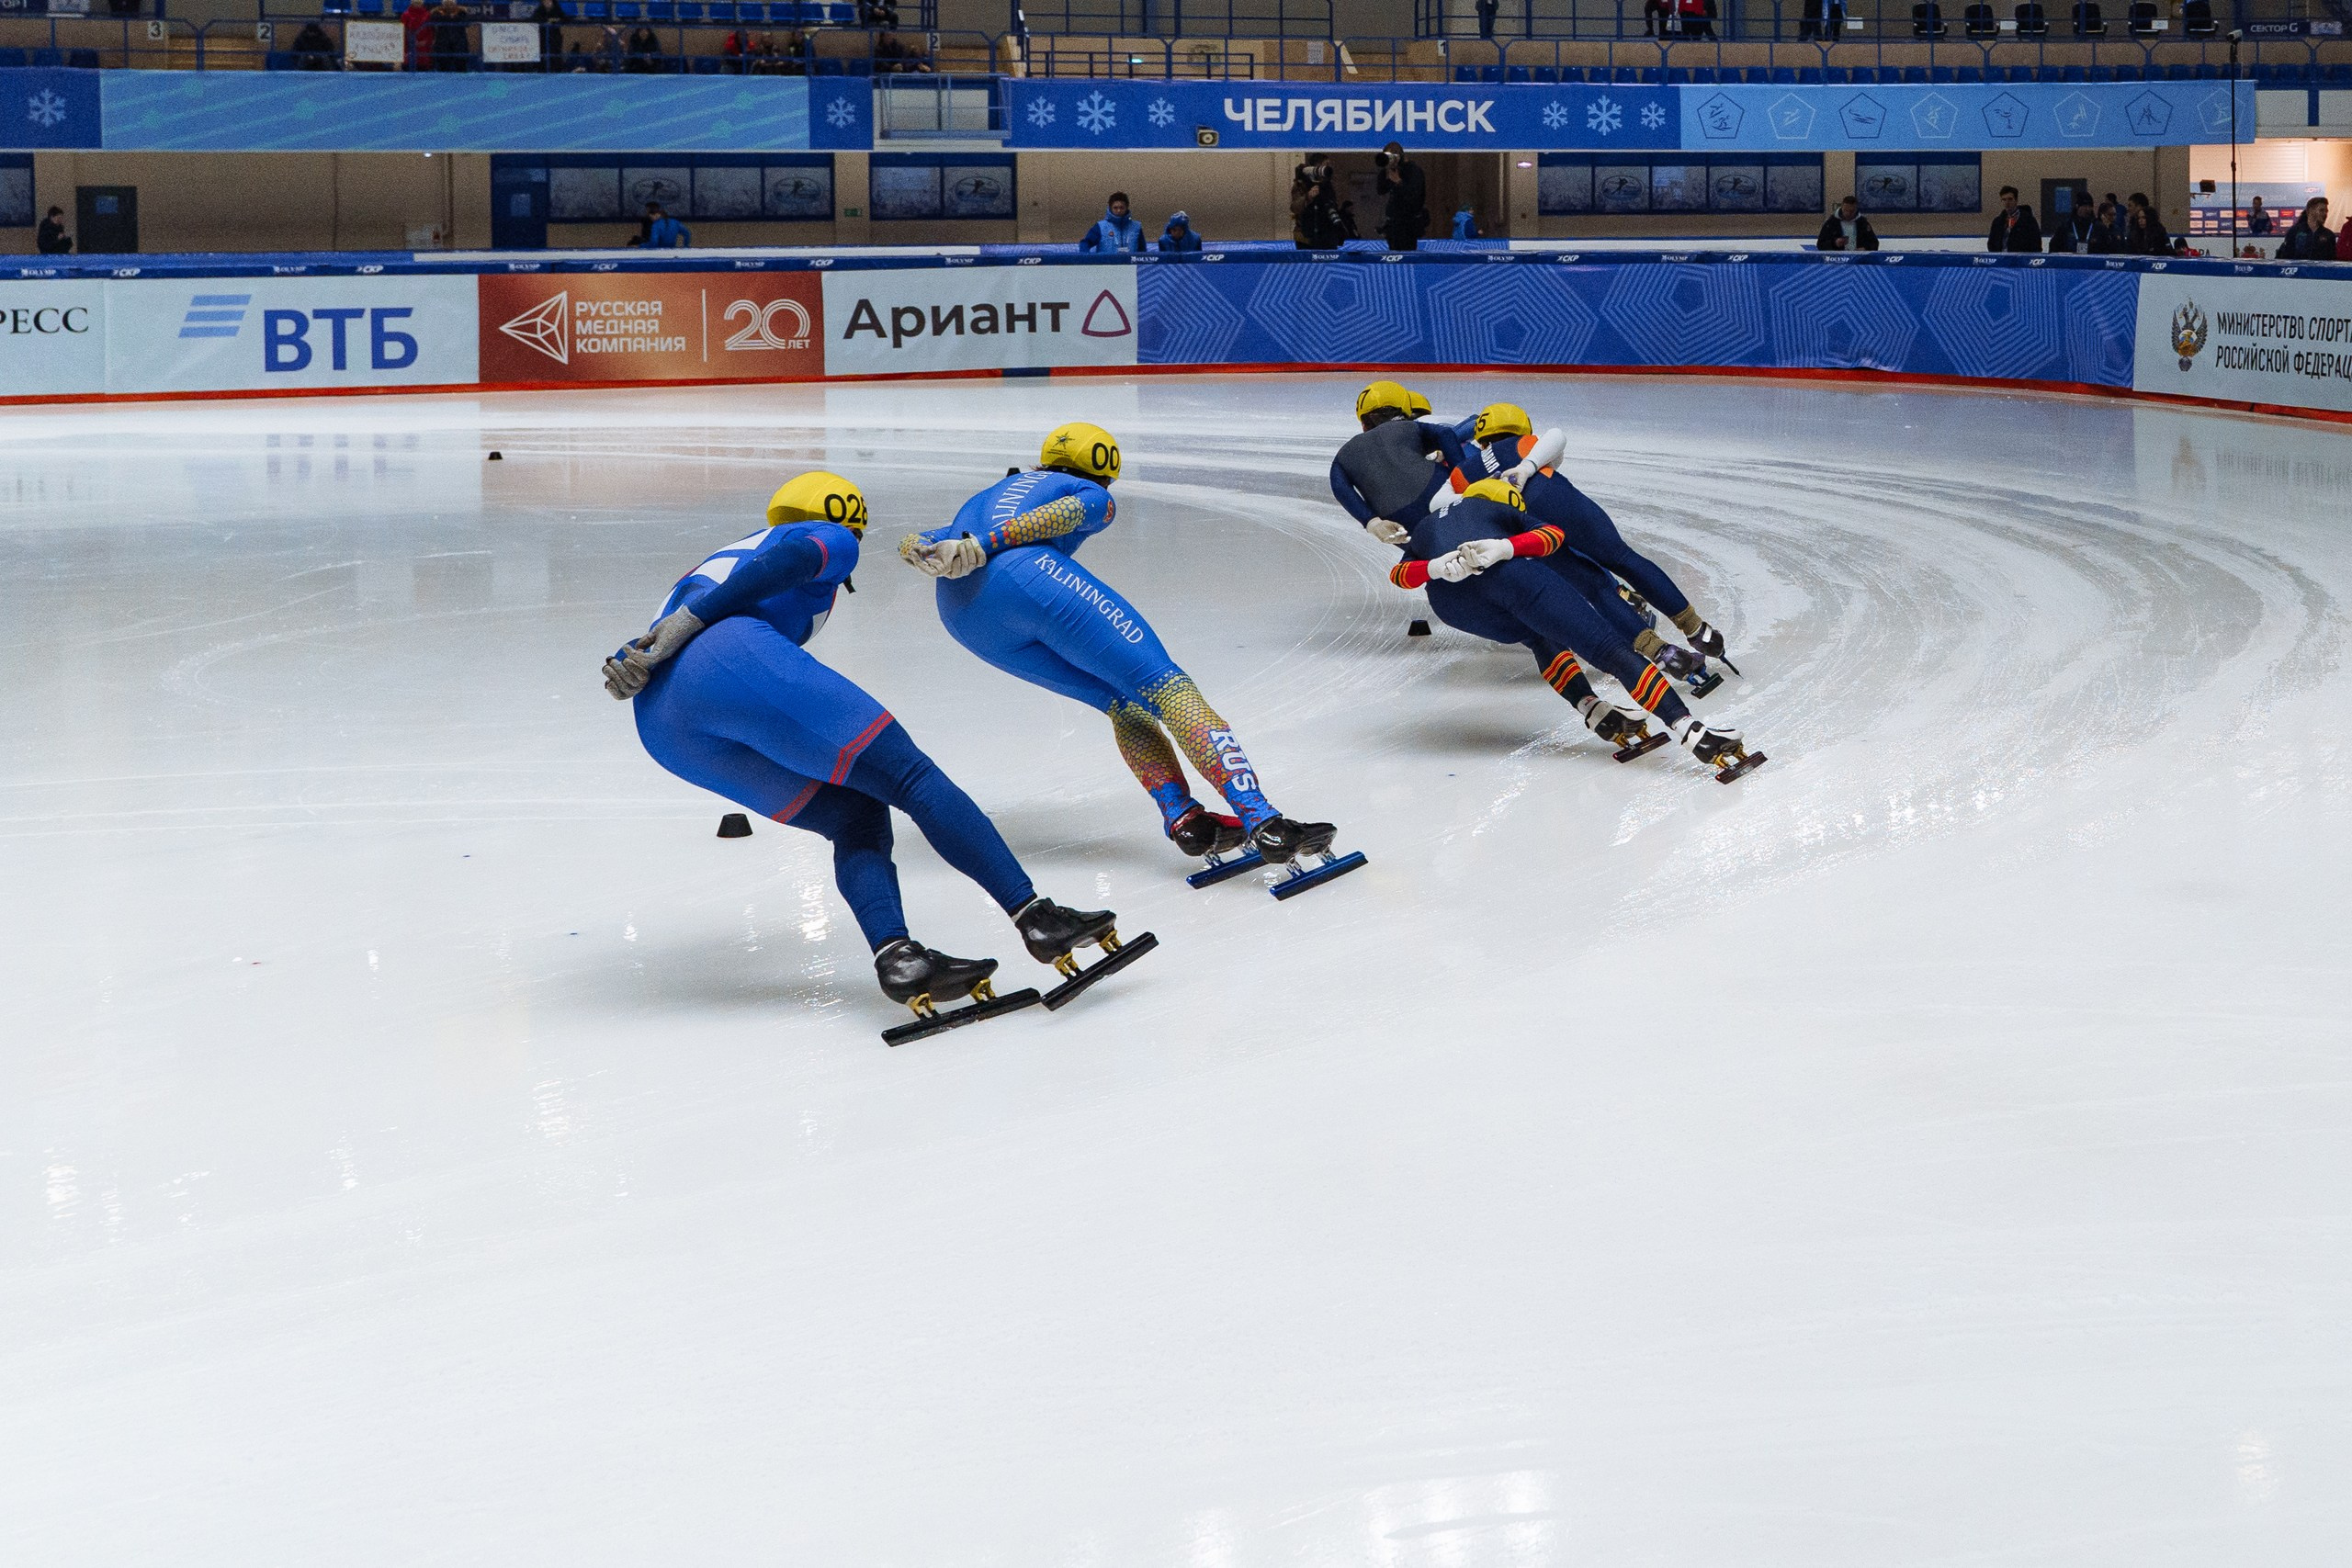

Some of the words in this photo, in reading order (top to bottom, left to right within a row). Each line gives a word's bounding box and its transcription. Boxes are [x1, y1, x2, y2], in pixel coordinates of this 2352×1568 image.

[151, 21, 161, 37] 3
[260, 25, 270, 39] 2
[2250, 24, 2287, 33] СЕКТОР
[2289, 23, 2298, 32] G
[1224, 98, 1496, 132] ЧЕЛЯБИНСК
[575, 300, 662, 317] РУССКАЯ
[723, 299, 810, 351] 20
[842, 299, 1070, 348] Ариант
[264, 308, 418, 372] ВТБ
[575, 319, 660, 335] МЕДНАЯ
[2216, 311, 2304, 340] МИНИСТЕРСТВО
[2308, 316, 2352, 344] СПОРТ
[576, 336, 686, 353] КОМПАНИЯ
[787, 339, 810, 349] ЛЕТ
[2215, 342, 2290, 374] РОССИЙСКОЙ
[2293, 350, 2352, 383] ФЕДЕРАЦ
[1091, 442, 1120, 472] 00
[991, 469, 1054, 529] LINING
[1034, 553, 1145, 645] KALININGRAD
[1209, 730, 1257, 792] RUS
